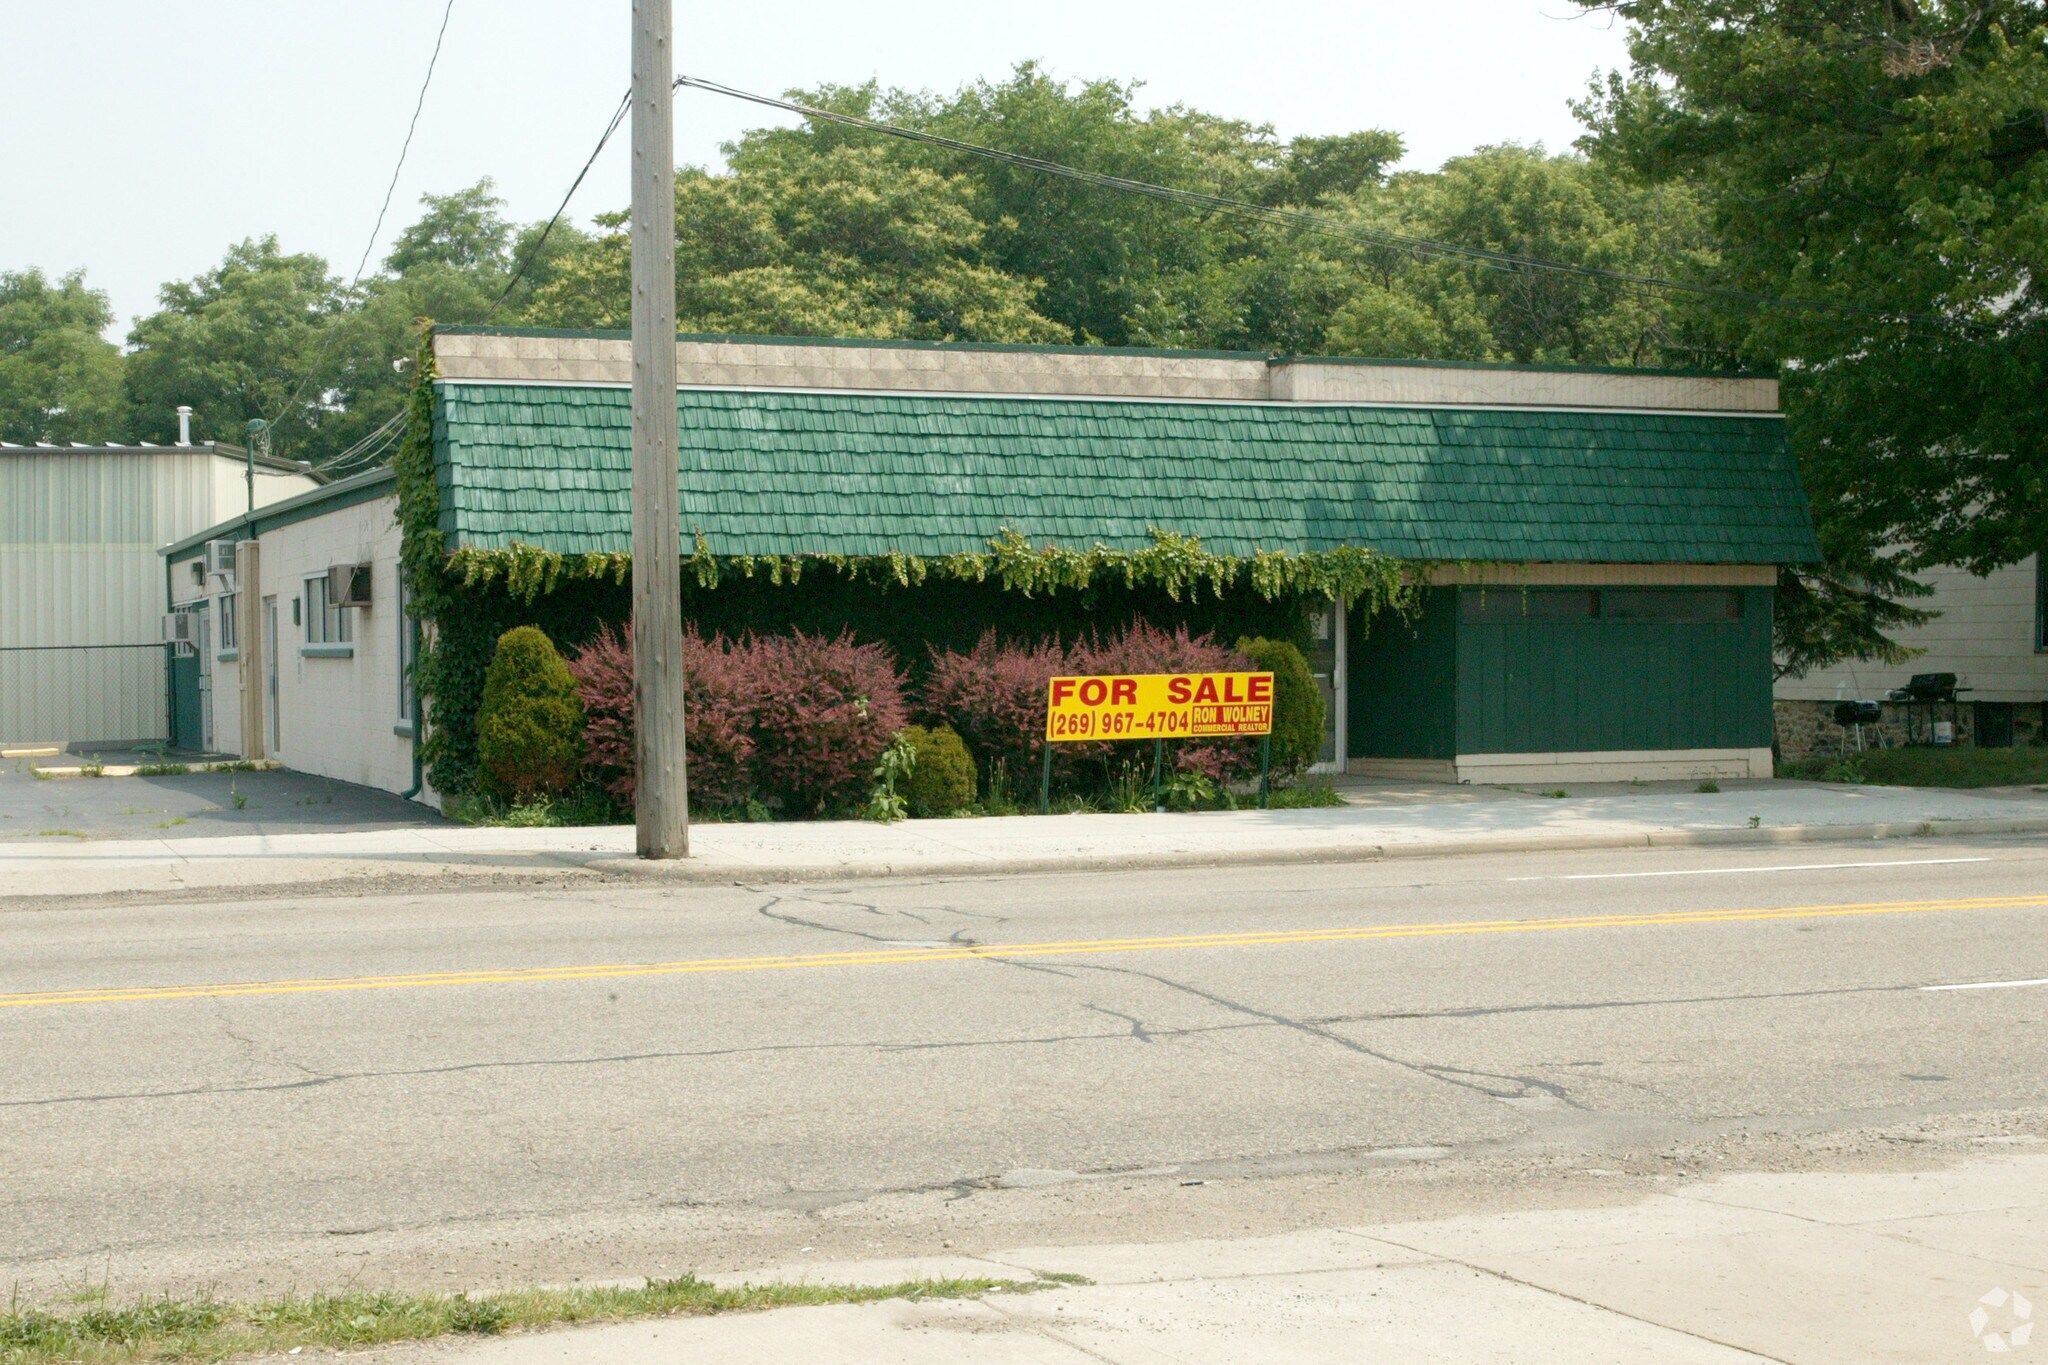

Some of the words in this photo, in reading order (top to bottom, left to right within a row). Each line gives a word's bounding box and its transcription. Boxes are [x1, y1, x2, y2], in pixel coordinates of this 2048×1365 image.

[1052, 679, 1138, 707] FOR
[1168, 676, 1272, 705] SALE
[1050, 710, 1096, 738] (269)
[1102, 711, 1189, 734] 967-4704
[1193, 706, 1217, 723] RON
[1223, 705, 1269, 722] WOLNEY
[1193, 723, 1236, 732] COMMERCIAL
